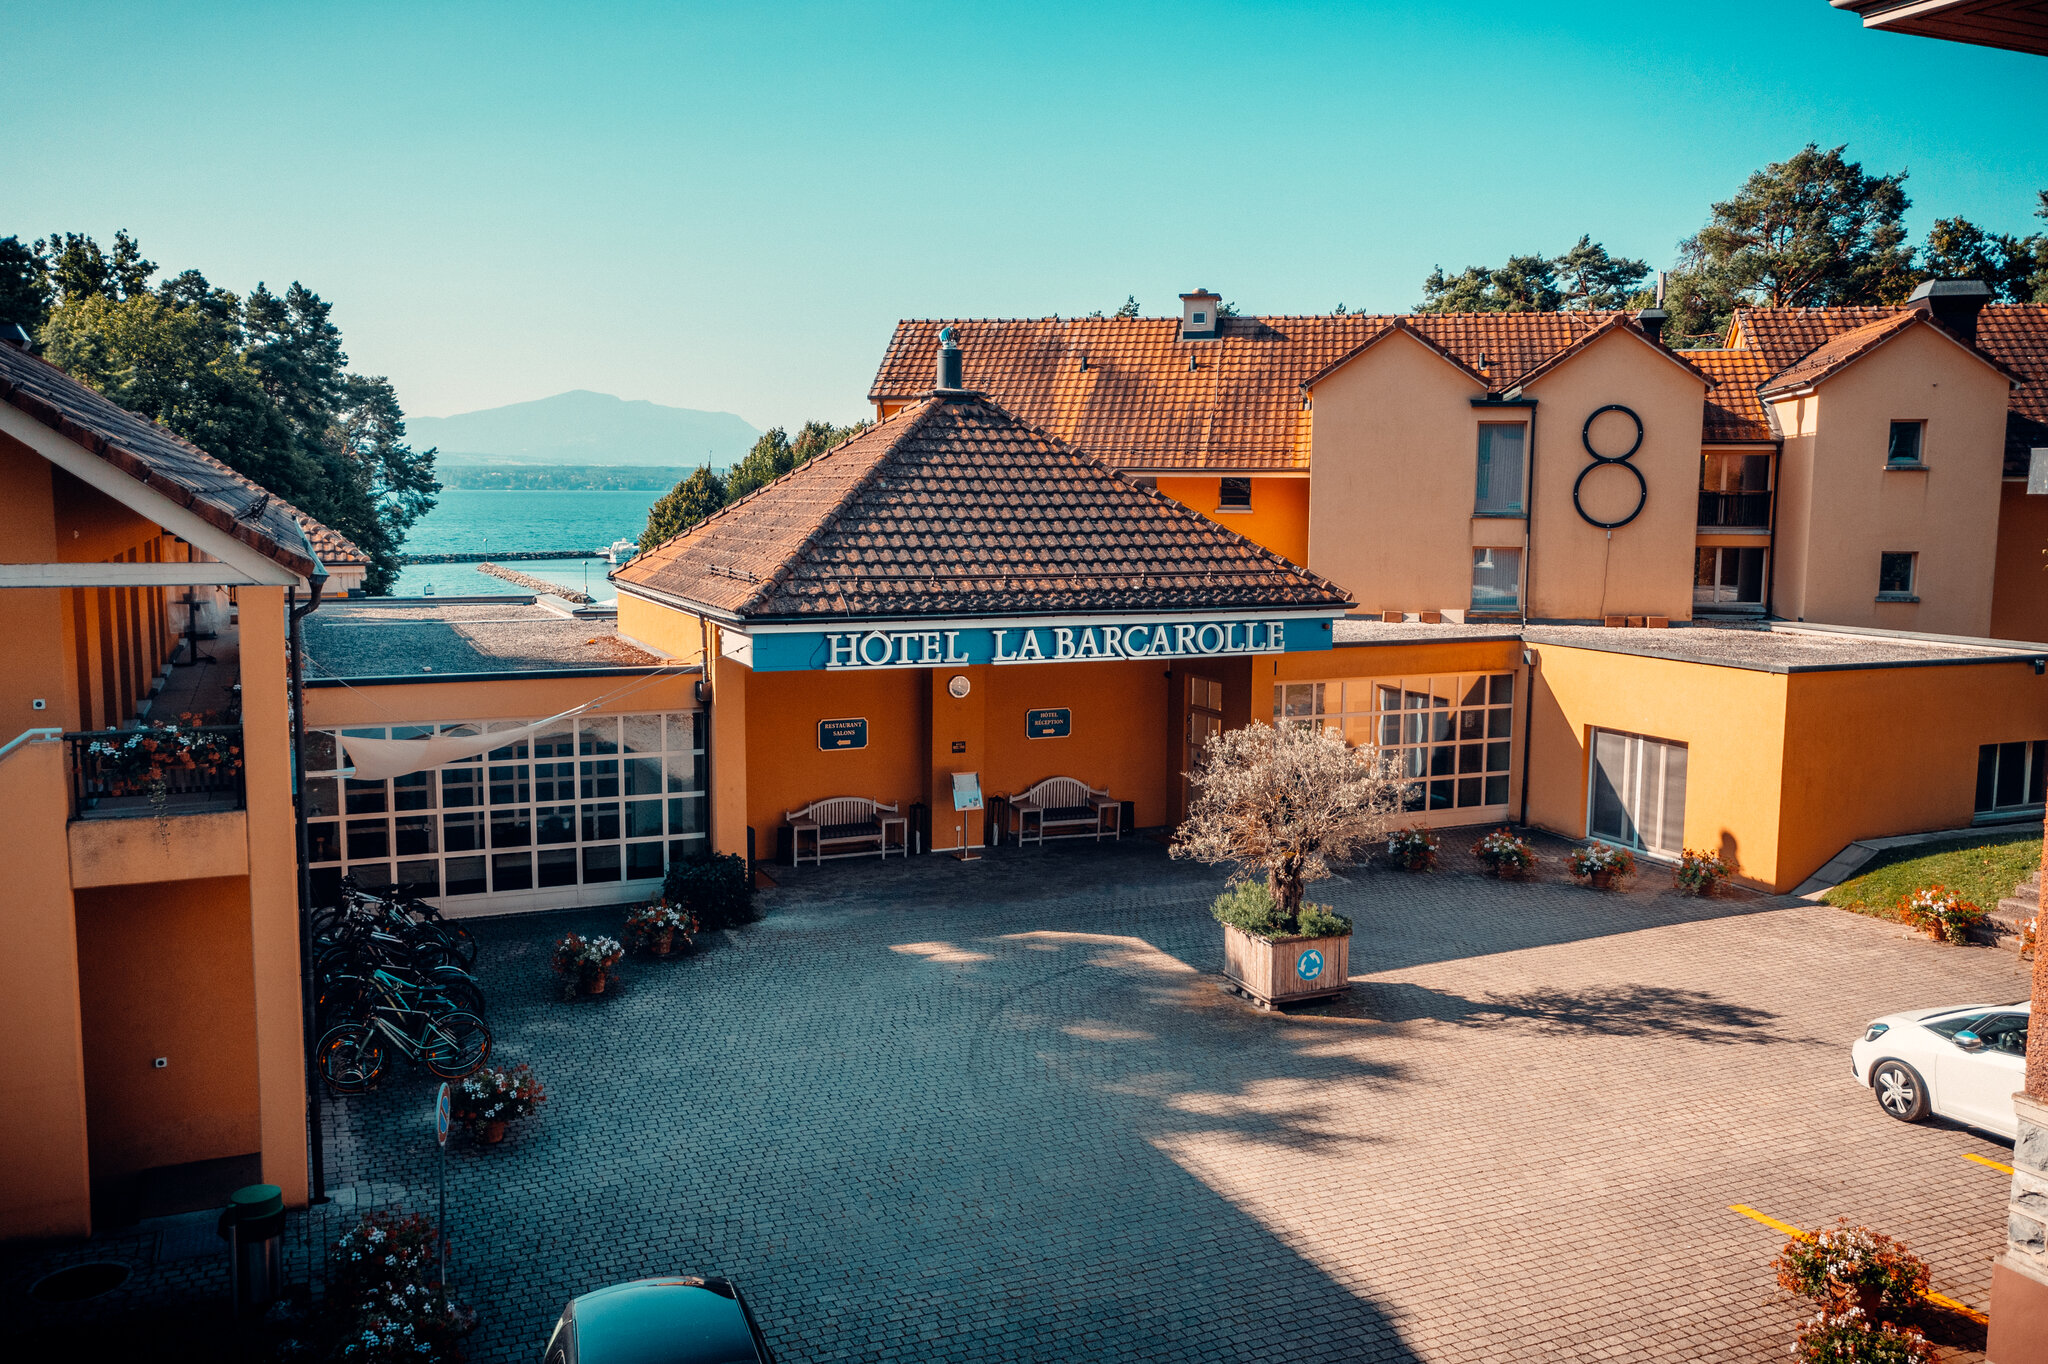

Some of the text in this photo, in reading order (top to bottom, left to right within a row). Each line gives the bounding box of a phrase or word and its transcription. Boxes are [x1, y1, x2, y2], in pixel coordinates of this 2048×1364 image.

[826, 622, 1286, 666] HÔTEL LA BARCAROLLE
[824, 721, 862, 729] RESTAURANT
